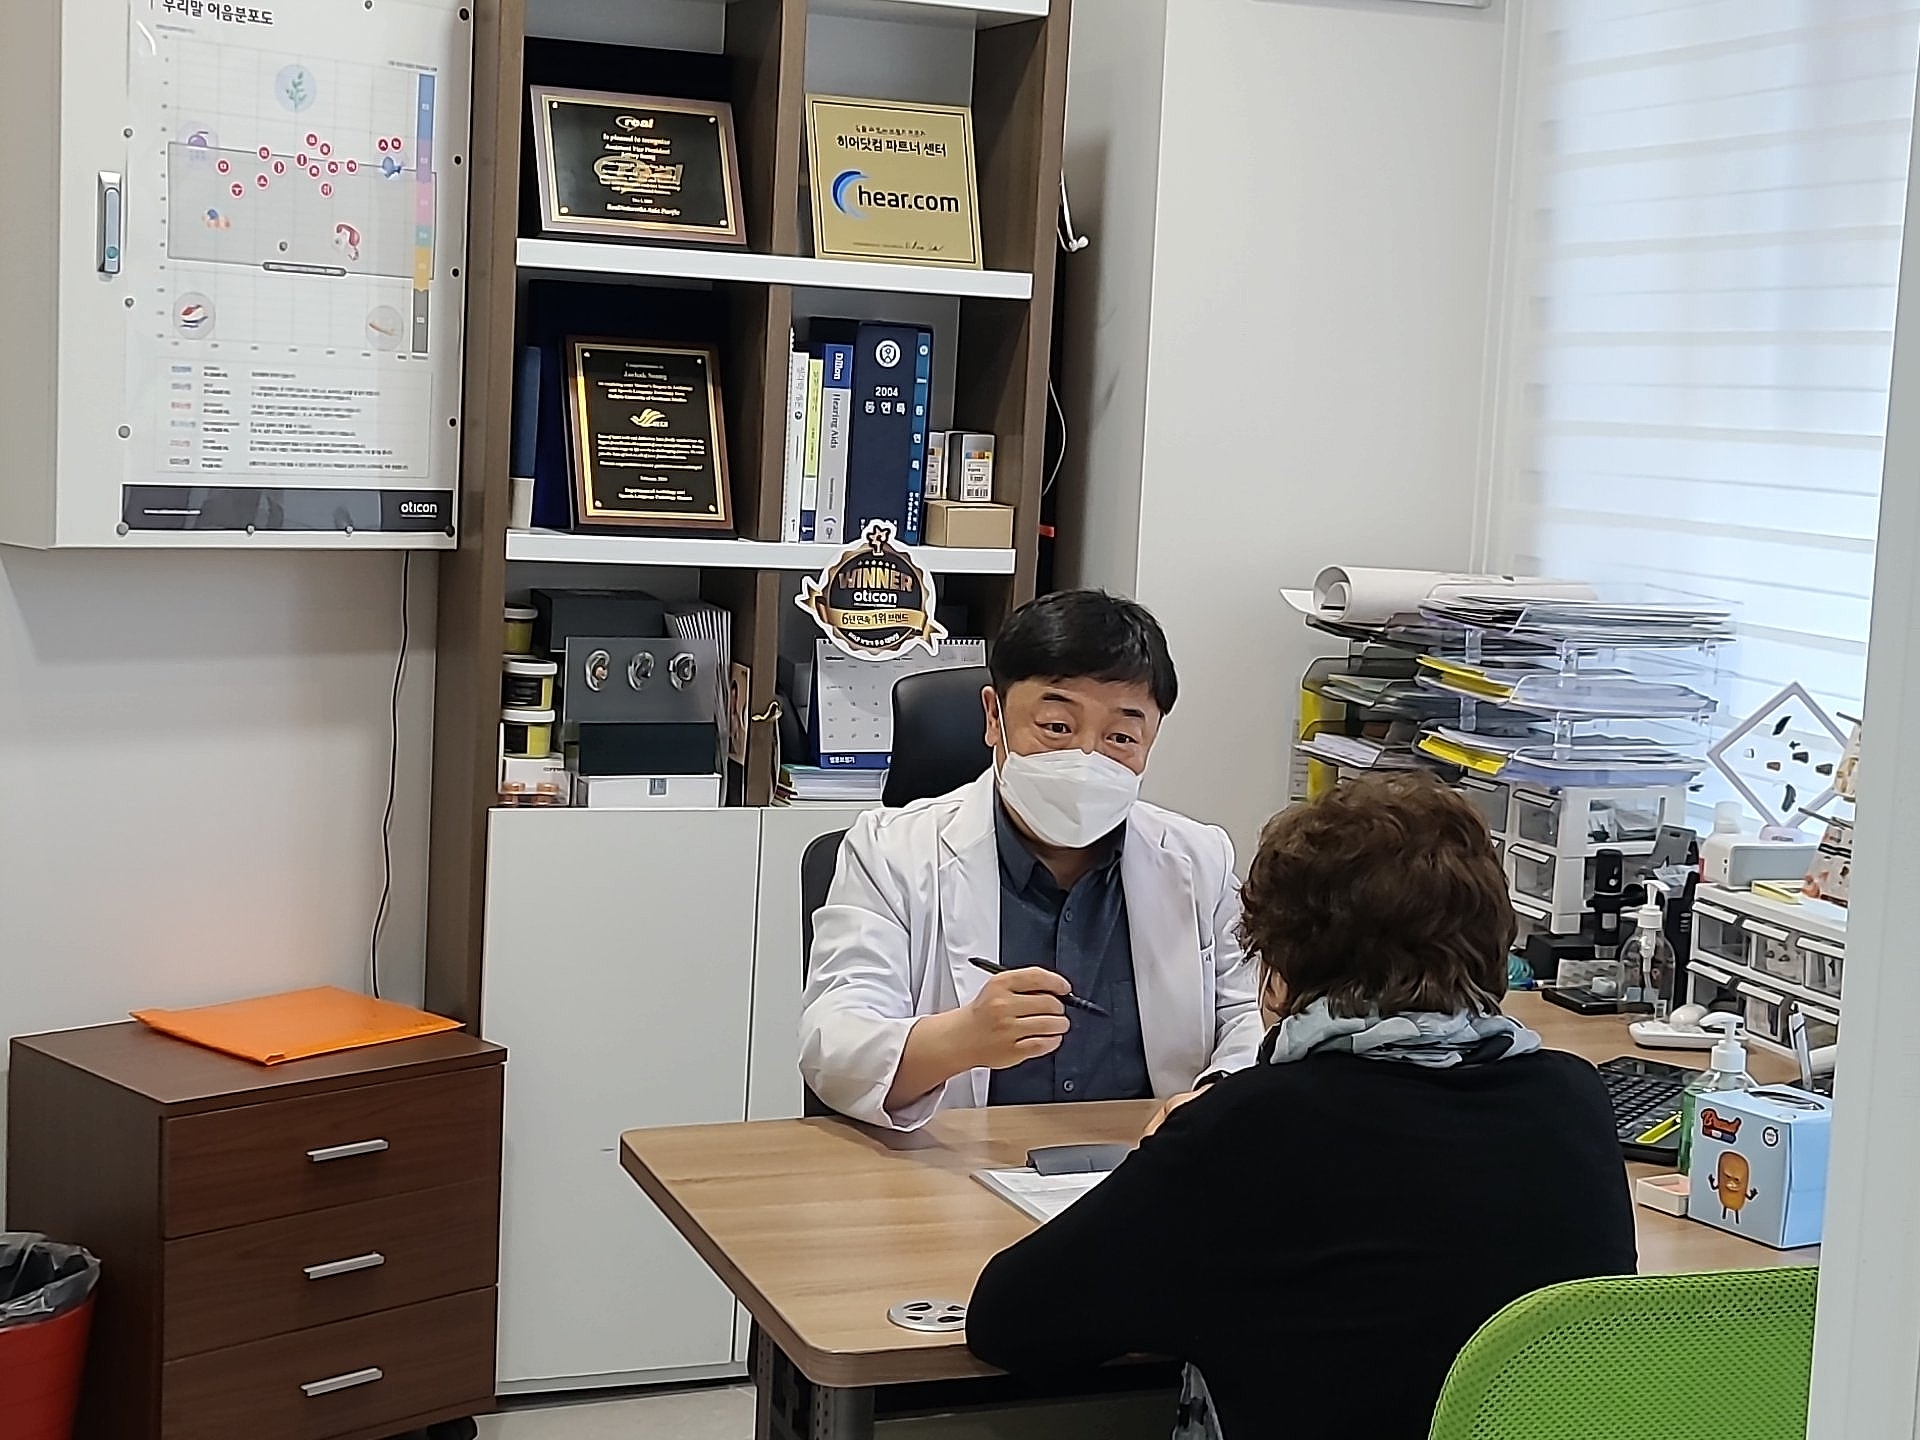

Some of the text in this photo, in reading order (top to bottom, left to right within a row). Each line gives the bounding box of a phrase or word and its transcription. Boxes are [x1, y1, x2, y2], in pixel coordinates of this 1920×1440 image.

[163, 0, 273, 25] 우리말 어음분포도
[837, 135, 946, 157] 히어닷컴 파트너 센터
[858, 185, 959, 212] hear.com
[833, 352, 844, 380] Dillon
[875, 386, 899, 397] 2004
[830, 393, 841, 449] Hearing Aids
[400, 501, 438, 513] oticon
[839, 567, 913, 592] WINNER
[853, 590, 898, 604] oticon
[842, 612, 909, 625] 6년 연속 1위 브랜드
